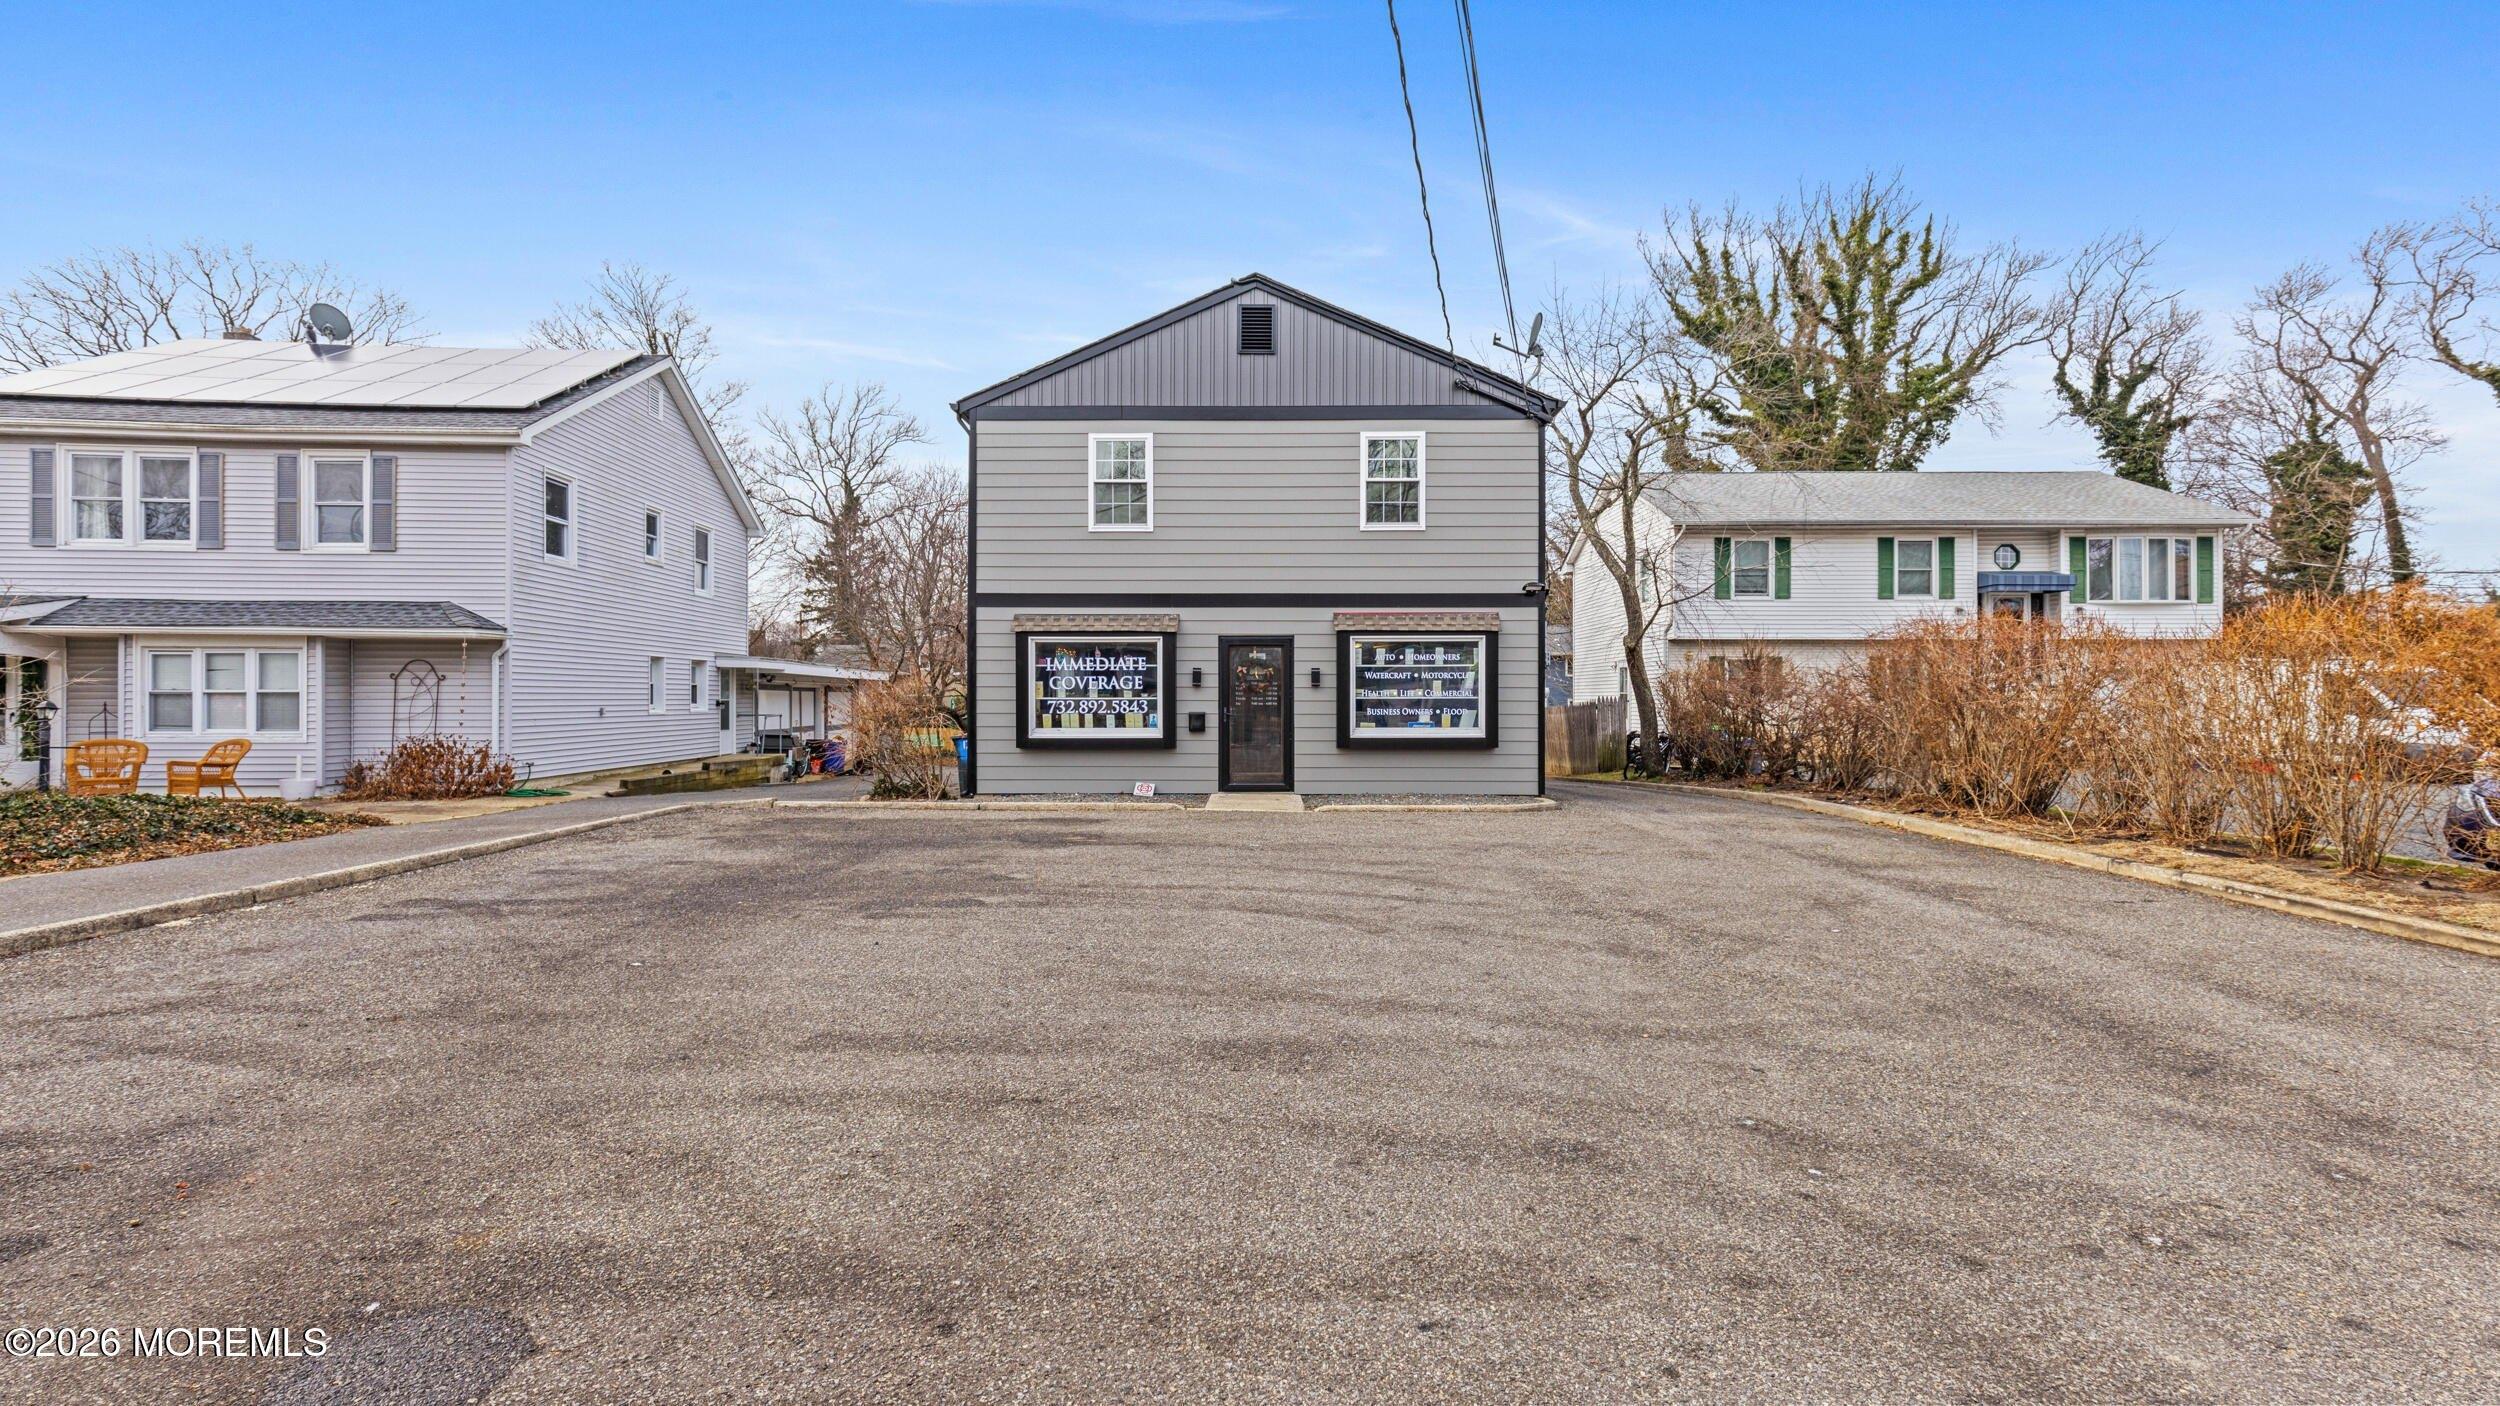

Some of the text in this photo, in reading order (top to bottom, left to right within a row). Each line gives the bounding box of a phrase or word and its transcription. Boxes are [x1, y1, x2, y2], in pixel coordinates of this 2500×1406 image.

[1374, 653, 1396, 661] AUTO
[1045, 656, 1147, 671] IMMEDIATE
[1364, 671, 1412, 679] WATERCRAFT
[1049, 675, 1144, 690] COVERAGE
[1361, 689, 1390, 697] HEALTH
[1424, 689, 1474, 697] COMMERCIAL
[1047, 699, 1149, 715] 732.892.5843
[1366, 707, 1401, 716] BUSINESS
[1401, 707, 1433, 716] OWNERS
